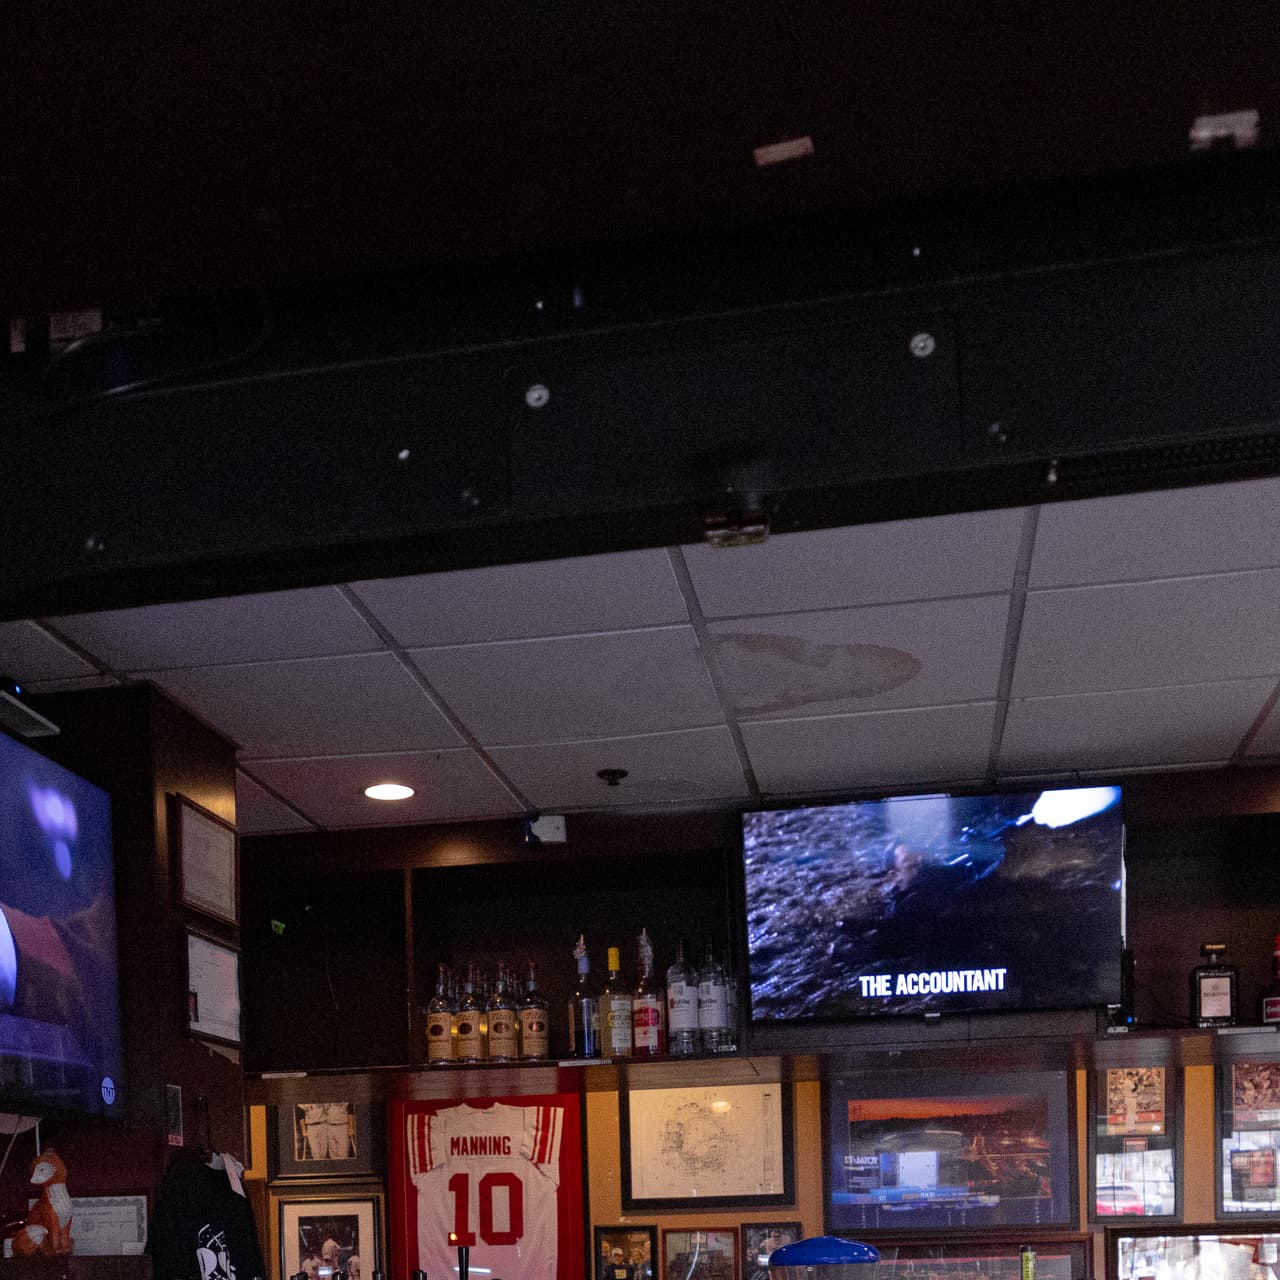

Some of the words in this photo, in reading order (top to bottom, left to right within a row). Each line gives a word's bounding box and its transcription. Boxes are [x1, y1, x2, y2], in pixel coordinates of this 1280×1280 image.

[859, 975, 892, 997] THE
[896, 968, 1007, 995] ACCOUNTANT
[450, 1136, 511, 1156] MANNING
[448, 1172, 524, 1247] 10
